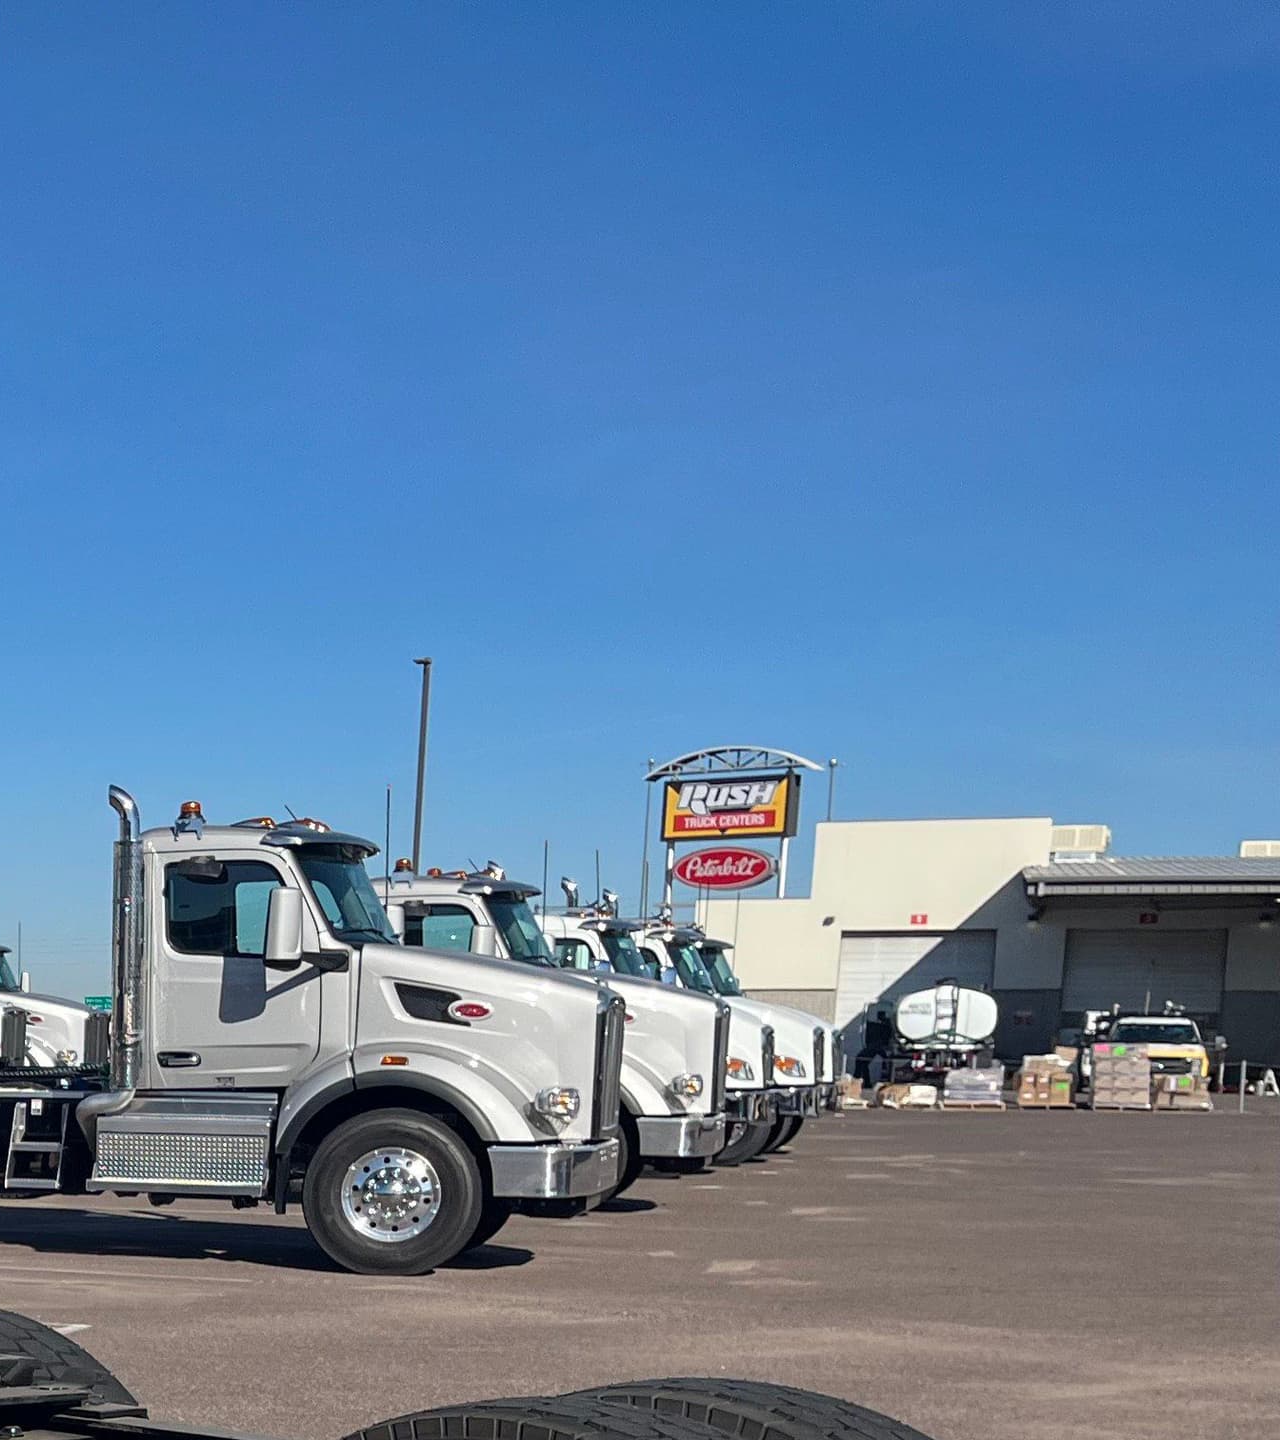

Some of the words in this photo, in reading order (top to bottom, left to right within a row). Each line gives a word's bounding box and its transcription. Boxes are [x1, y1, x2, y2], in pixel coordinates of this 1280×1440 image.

[677, 782, 779, 816] RUSH
[683, 816, 717, 829] TRUCK
[719, 813, 765, 827] CENTERS
[685, 856, 762, 880] Peterbilt
